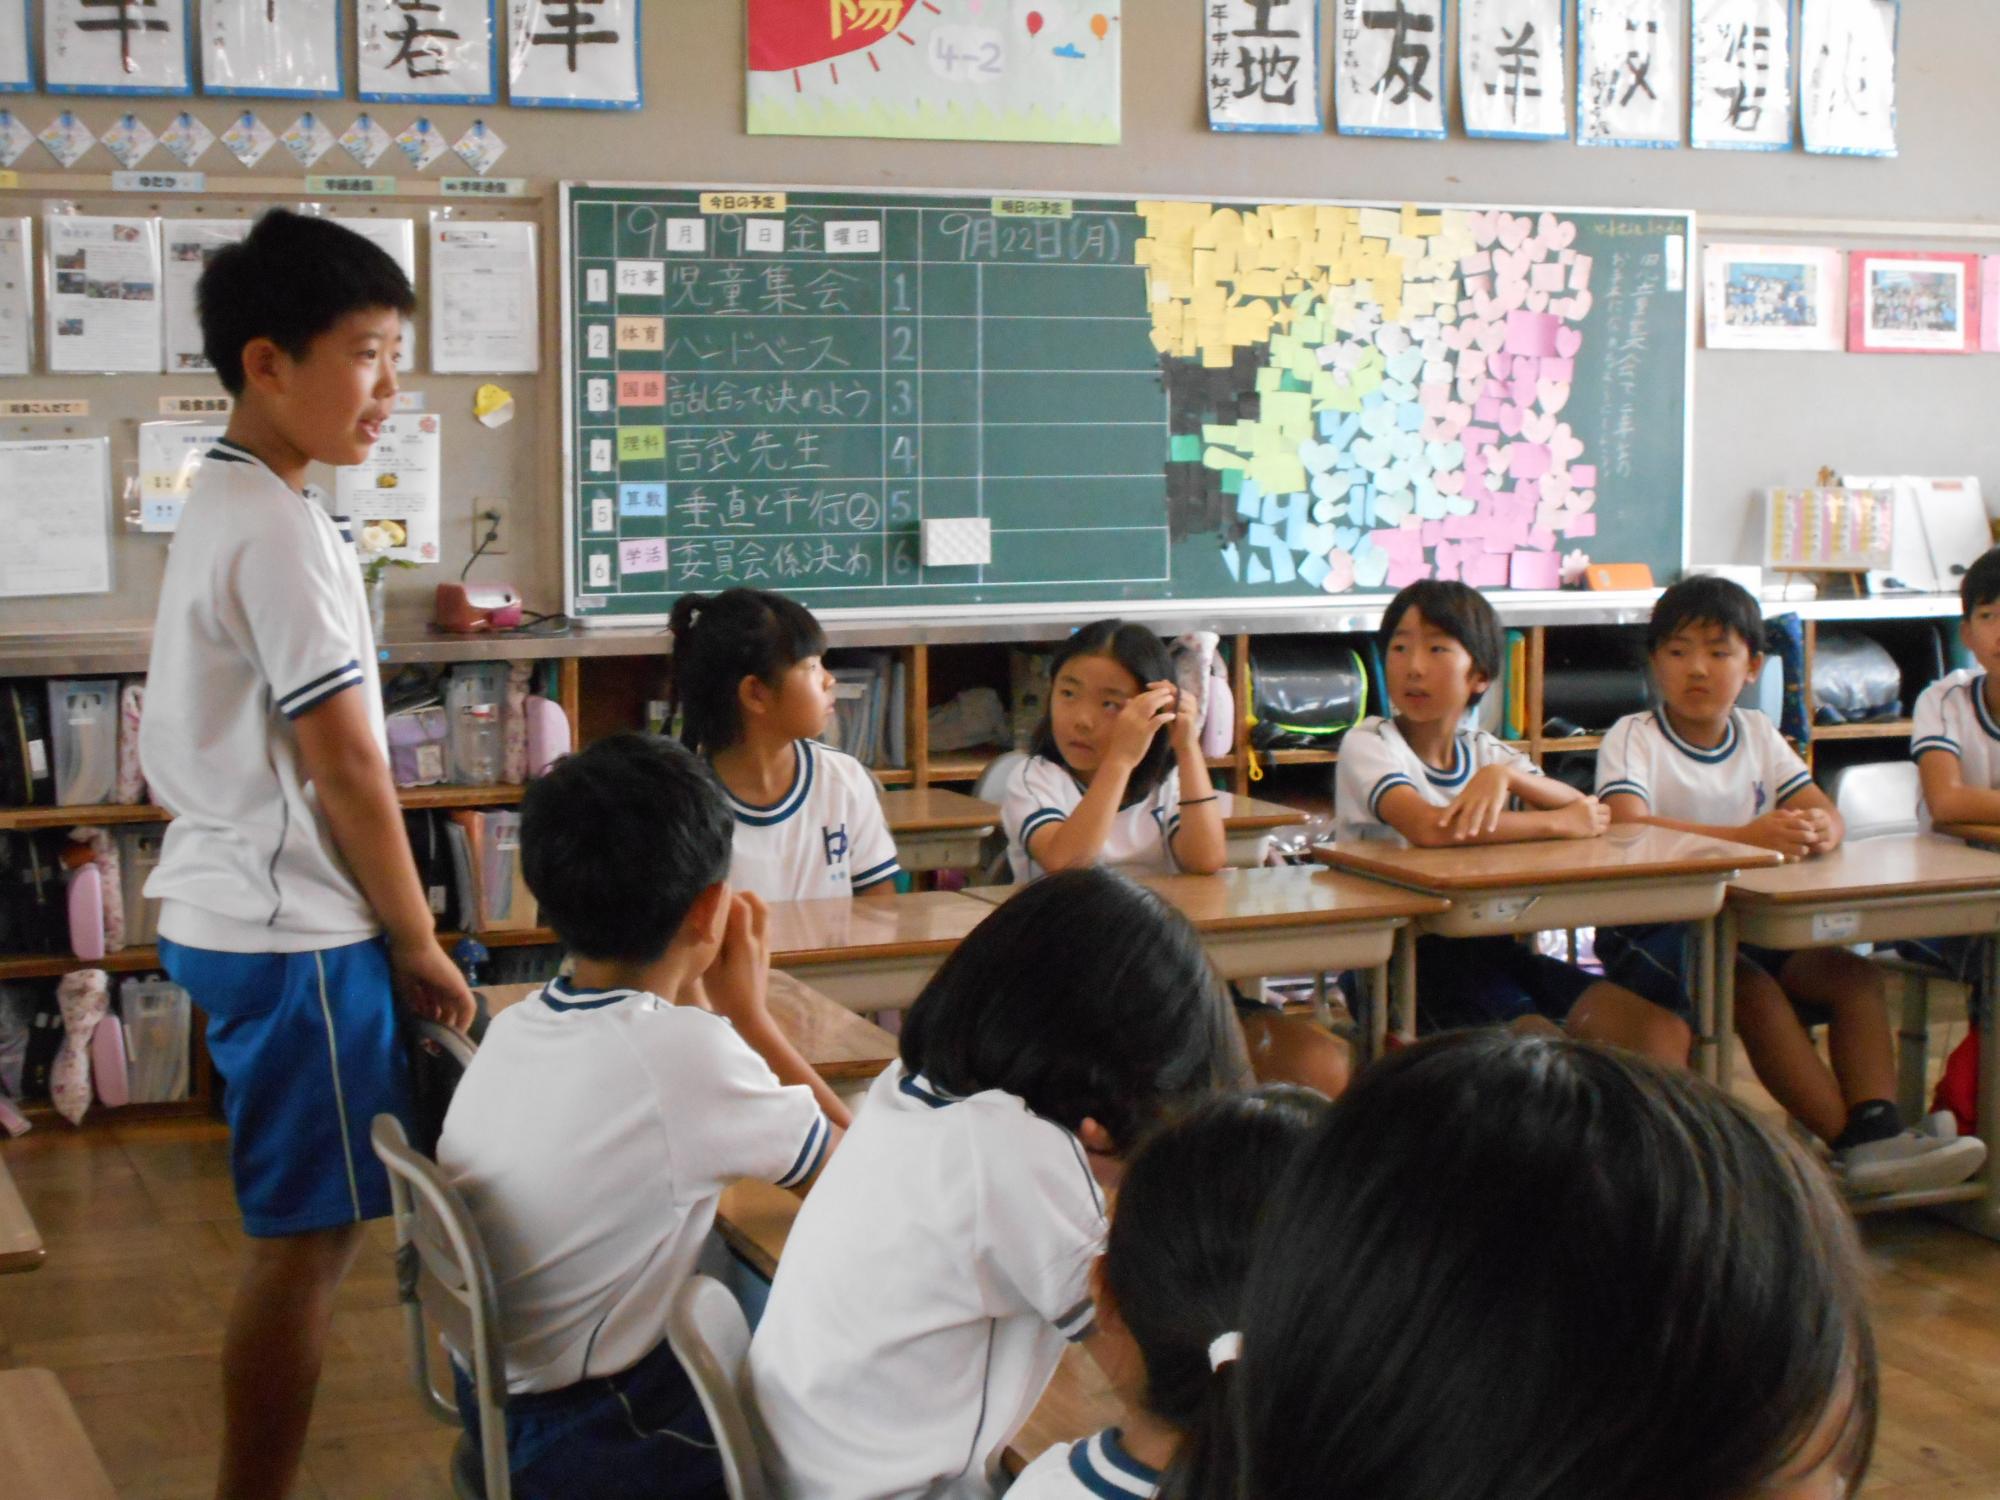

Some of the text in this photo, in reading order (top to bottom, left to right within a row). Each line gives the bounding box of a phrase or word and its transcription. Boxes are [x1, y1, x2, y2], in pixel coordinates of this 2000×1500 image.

[935, 37, 1001, 72] 4-2
[710, 195, 775, 209] 今日の予定
[1001, 201, 1063, 214] 明日の予定
[622, 269, 658, 285] 行事
[672, 266, 860, 315] 児童集会
[893, 274, 911, 311] 1
[622, 326, 658, 342] 体育
[893, 327, 914, 361] 2
[665, 332, 849, 371] ハンドベース
[622, 381, 658, 397] 国語
[892, 379, 911, 415] 3
[623, 435, 659, 451] 理科
[891, 435, 915, 474] 4
[625, 491, 661, 507] 算数
[890, 490, 911, 521] 5
[624, 548, 660, 565] 学活
[893, 540, 912, 575] 6
